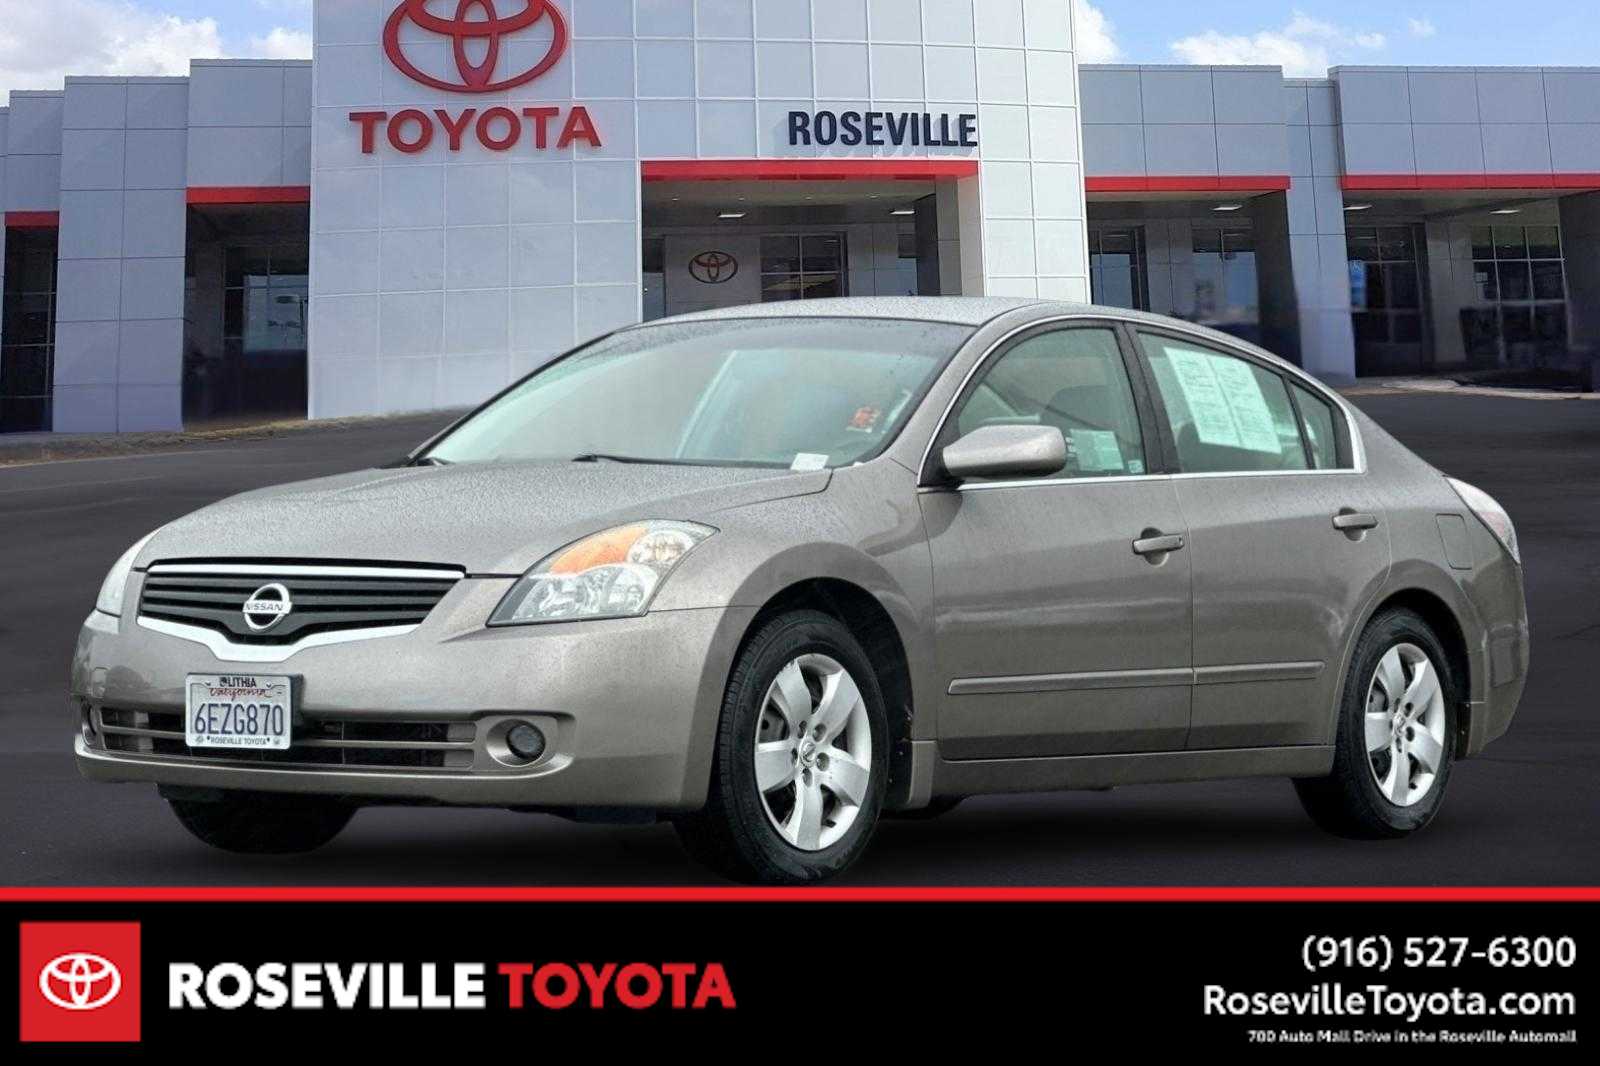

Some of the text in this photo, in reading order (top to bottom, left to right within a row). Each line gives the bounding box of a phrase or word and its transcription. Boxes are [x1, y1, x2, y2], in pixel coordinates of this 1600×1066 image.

[349, 105, 603, 154] TOYOTA
[788, 110, 978, 148] ROSEVILLE
[245, 602, 284, 611] NISSAN
[194, 703, 284, 736] 6EZG870
